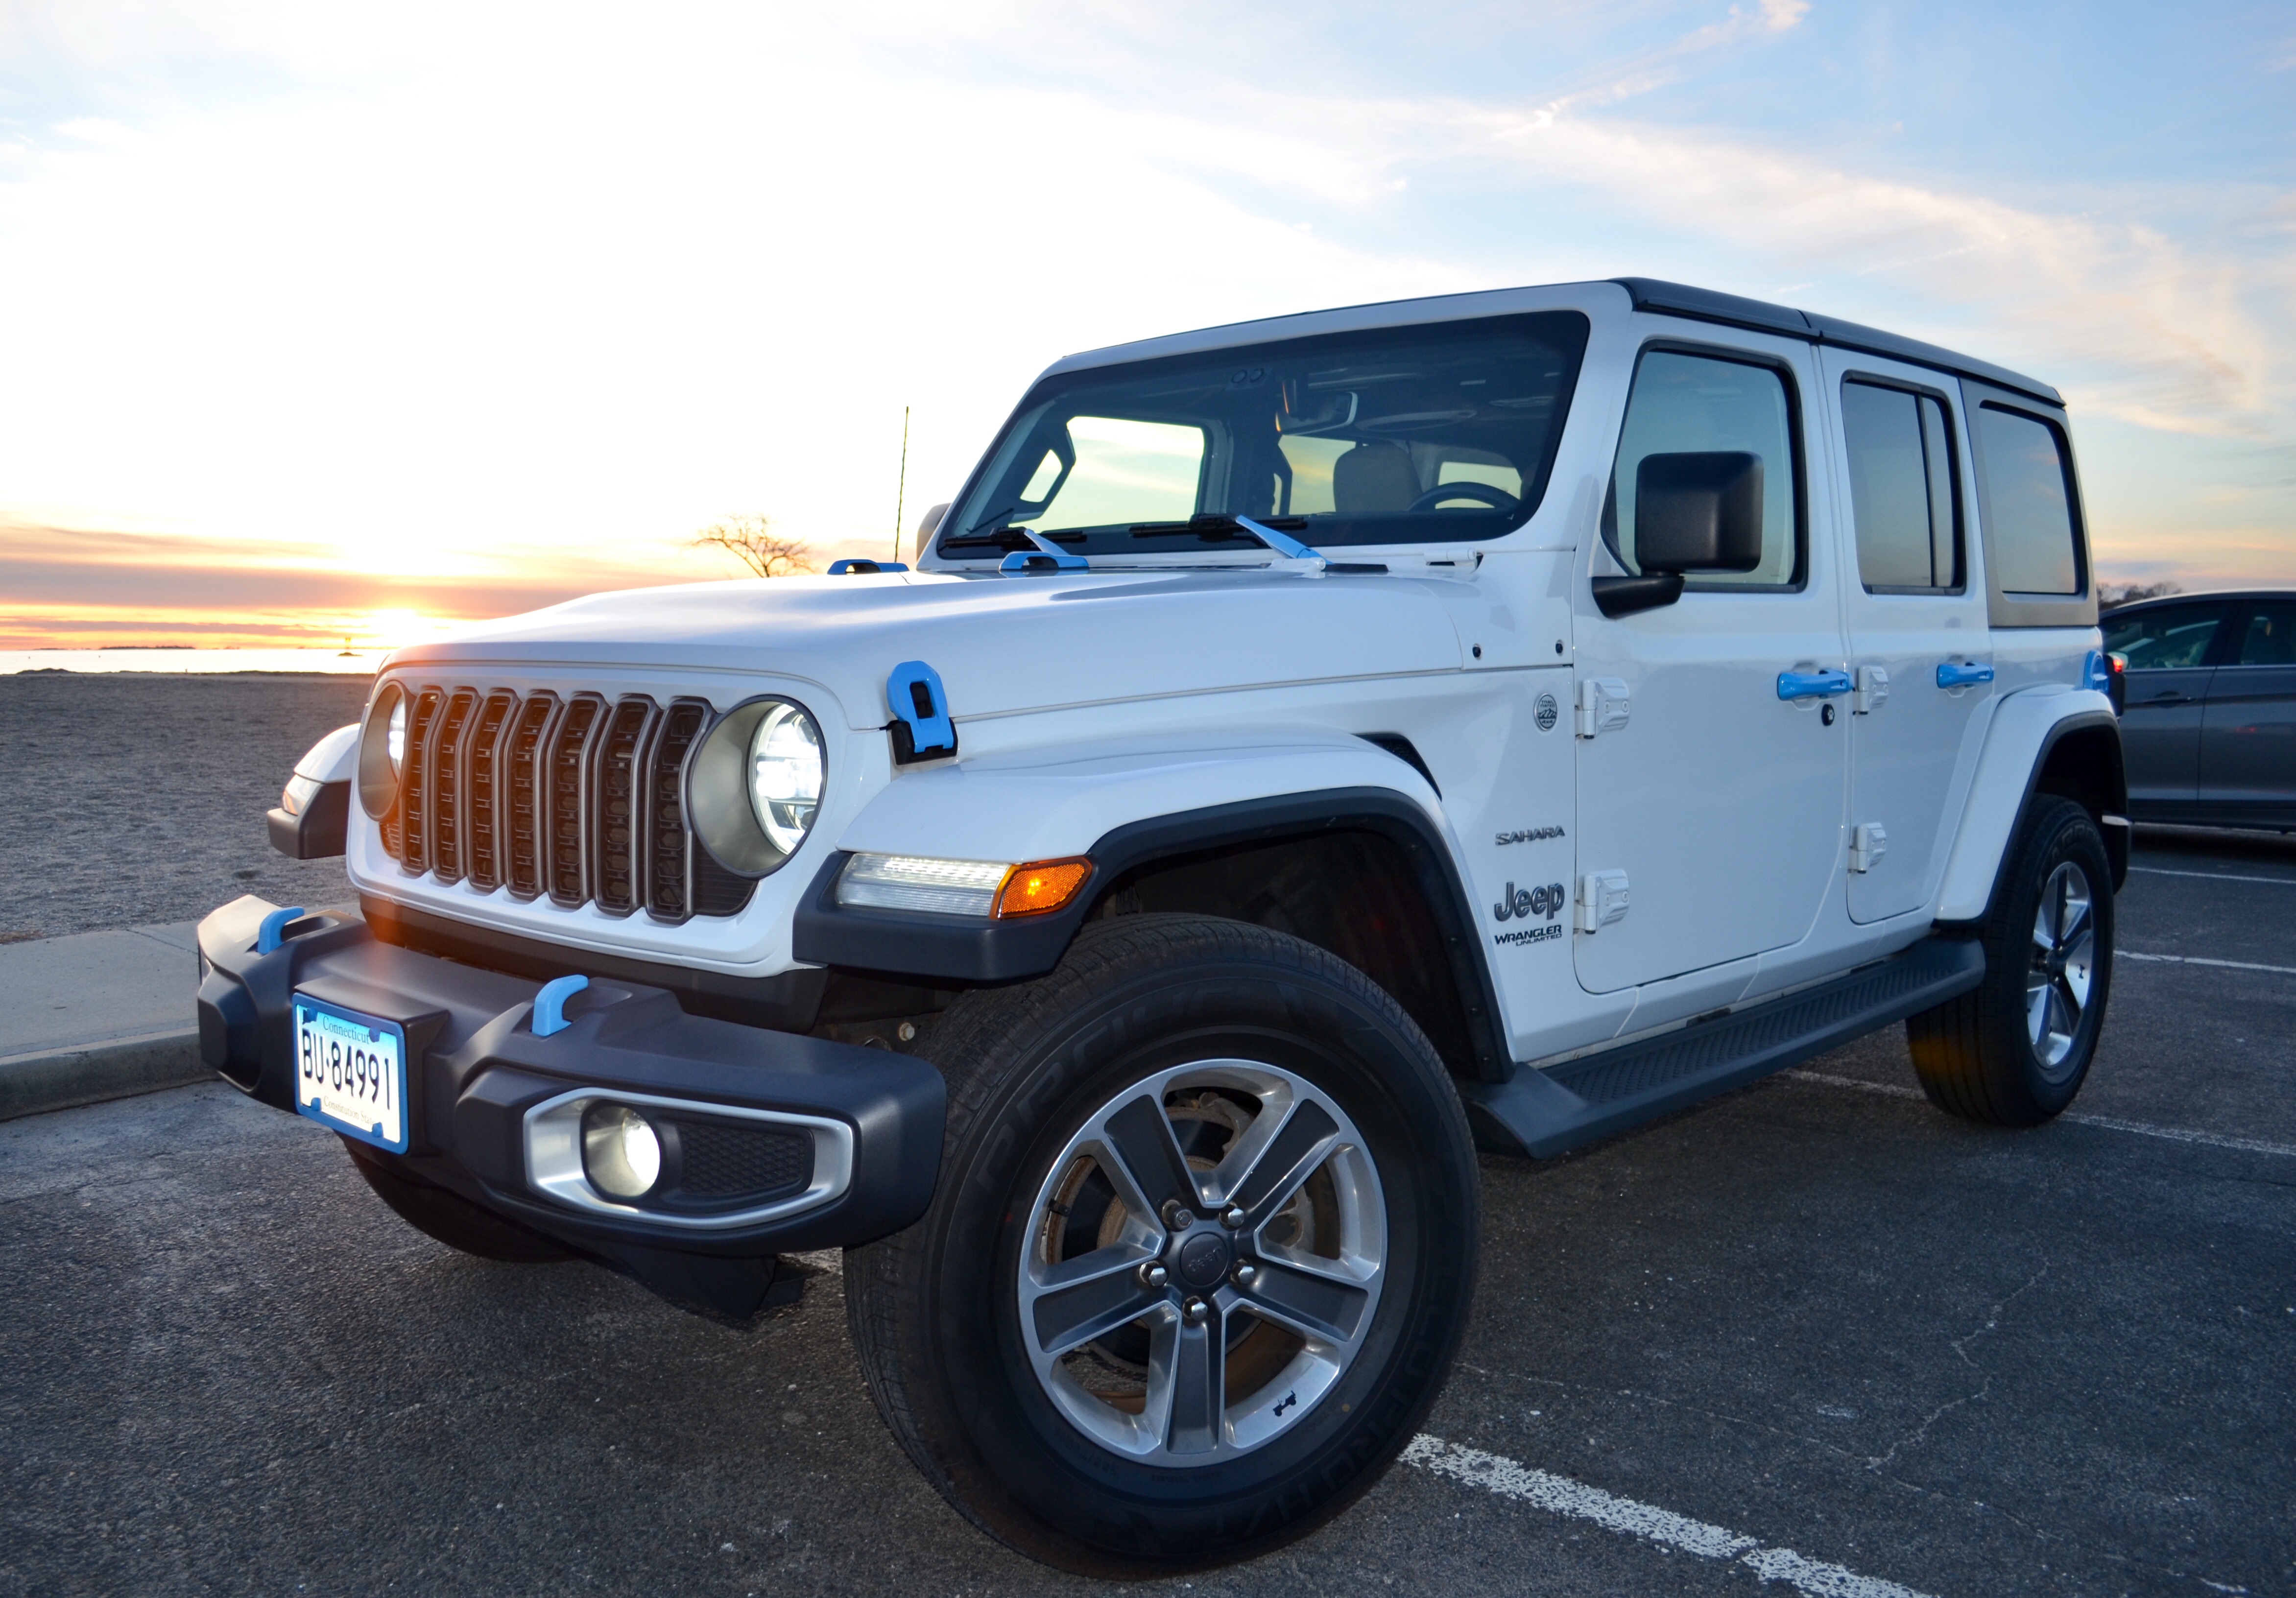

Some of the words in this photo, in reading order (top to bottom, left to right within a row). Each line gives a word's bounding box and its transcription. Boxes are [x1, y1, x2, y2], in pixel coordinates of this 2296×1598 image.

[1495, 825, 1565, 846] SAHARA
[1494, 882, 1565, 922] Jeep
[1494, 924, 1562, 945] WRANGLER
[1516, 933, 1562, 946] UNLIMITED
[323, 1016, 370, 1045] Connecticut
[324, 1096, 359, 1120] Constitution
[1188, 1246, 1223, 1273] Jeep
